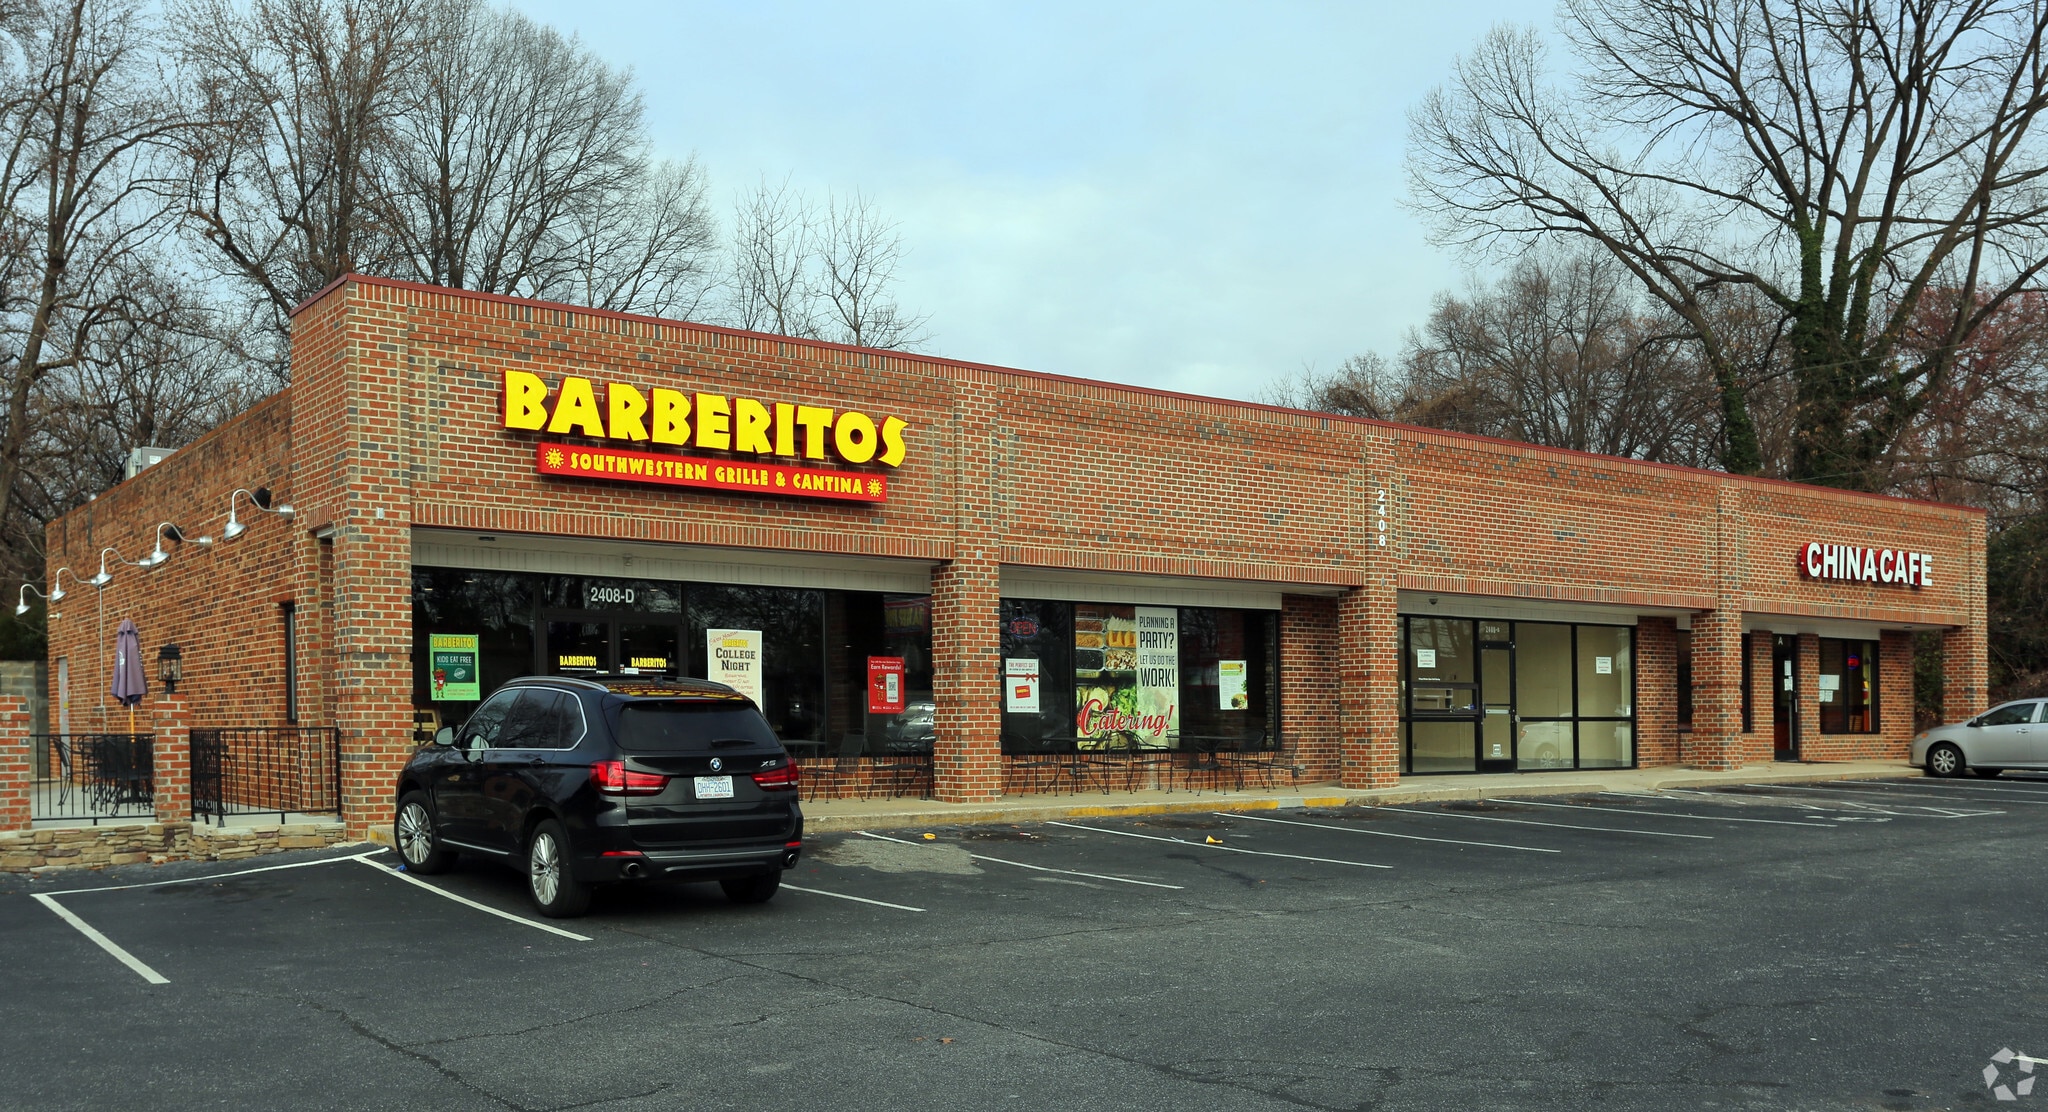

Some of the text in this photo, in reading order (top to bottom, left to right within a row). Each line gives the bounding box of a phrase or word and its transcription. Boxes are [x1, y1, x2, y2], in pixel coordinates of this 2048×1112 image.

[502, 370, 908, 467] BARBERITOS
[570, 452, 863, 494] SOUTHWESTERN GRILLE & CANTINA
[1378, 490, 1386, 546] 2408
[1802, 542, 1933, 586] CHINA CAFE
[590, 587, 635, 603] 2408-D
[1010, 621, 1036, 635] OPEN
[1139, 616, 1175, 629] PLANNING A
[433, 637, 475, 649] BARBERITOS
[1140, 631, 1175, 649] PARTY?
[1777, 636, 1784, 645] A
[716, 647, 756, 659] COLLEGE
[450, 656, 459, 664] EAT
[460, 656, 472, 664] FREE
[559, 655, 597, 666] BARBERITOS
[631, 657, 667, 668] BARBERITOS
[721, 660, 750, 671] NIGHT
[1140, 655, 1175, 666] LET US DO THE
[1140, 668, 1175, 688] WORK!
[1080, 698, 1174, 736] Catering!
